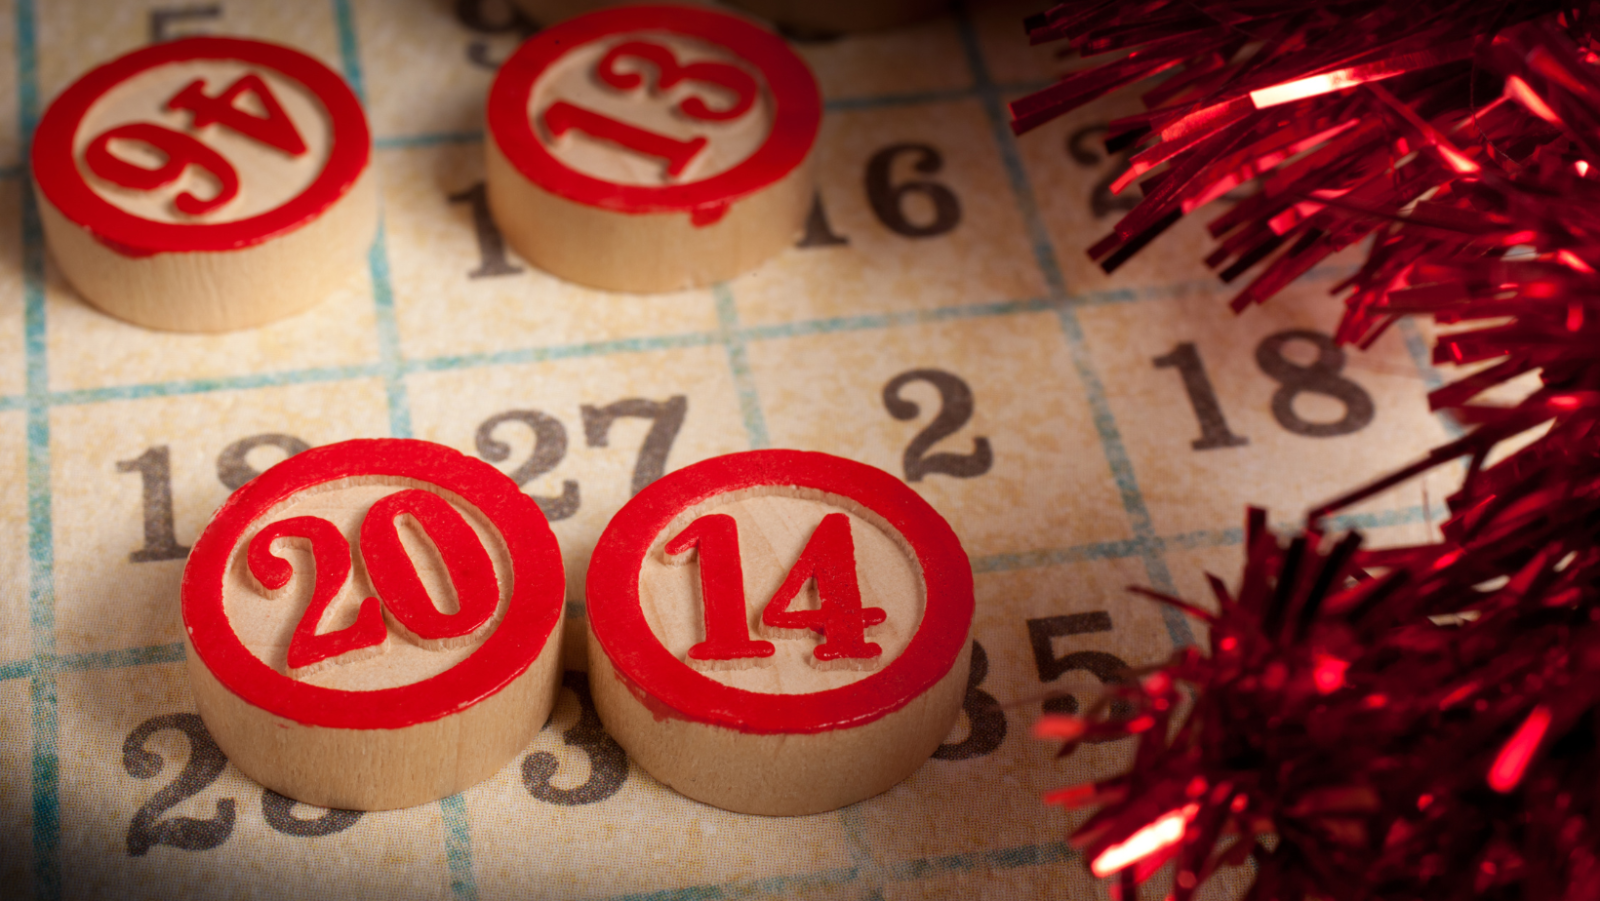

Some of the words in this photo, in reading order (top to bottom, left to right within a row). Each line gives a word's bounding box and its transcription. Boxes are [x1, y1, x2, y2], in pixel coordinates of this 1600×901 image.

[84, 72, 309, 217] 46
[541, 40, 758, 180] 13
[475, 395, 687, 522] 27
[882, 369, 993, 482] 2
[1152, 328, 1375, 450] 18
[247, 488, 499, 669] 20
[664, 513, 887, 661] 14
